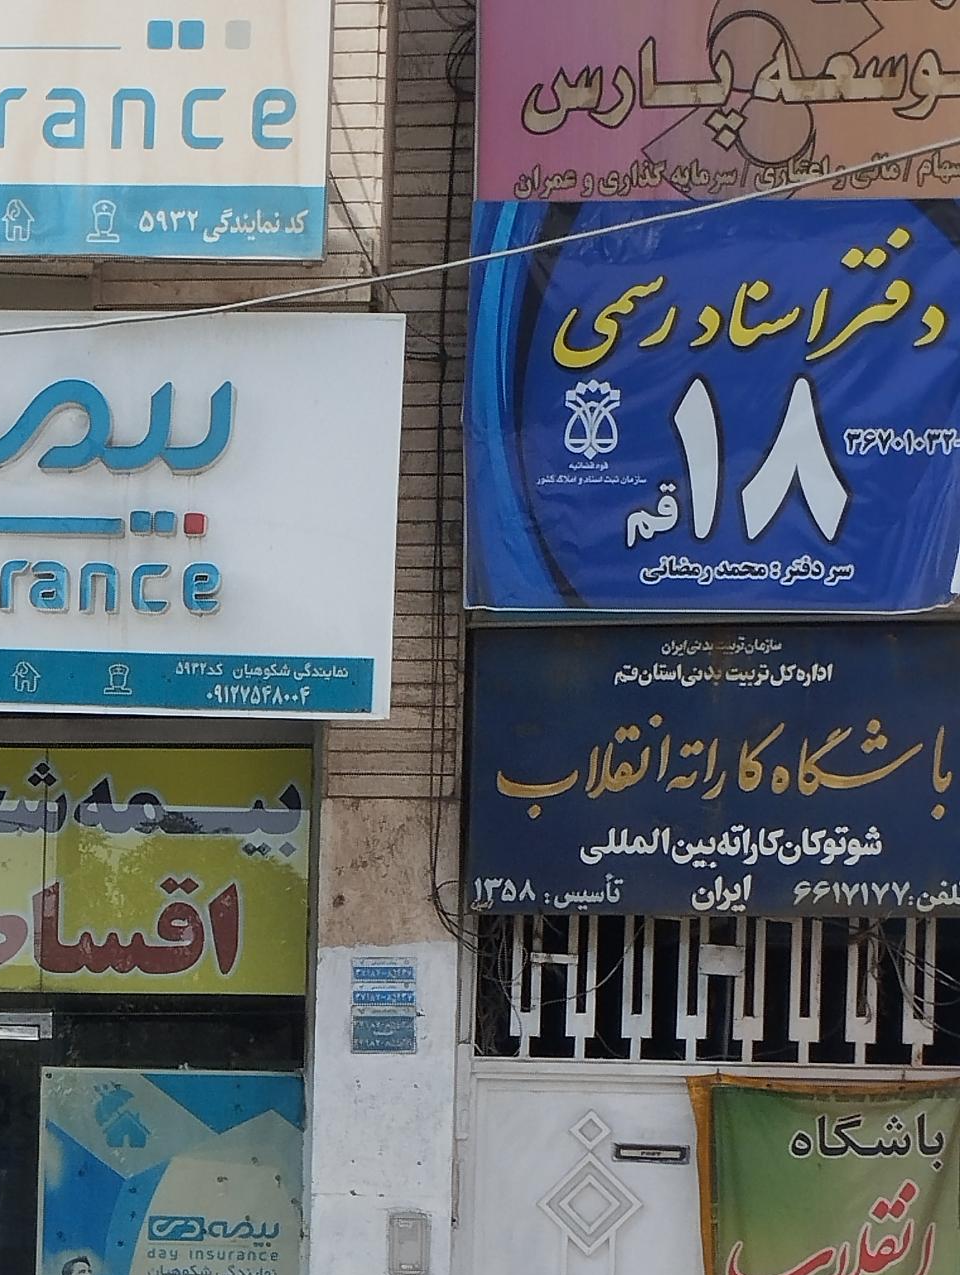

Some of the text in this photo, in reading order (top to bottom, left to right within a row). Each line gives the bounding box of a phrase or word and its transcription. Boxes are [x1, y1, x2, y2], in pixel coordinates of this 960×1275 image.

[521, 36, 746, 151] پارس
[514, 163, 577, 199] عمران
[581, 173, 594, 197] و
[671, 158, 739, 194] سرمایه
[138, 207, 309, 244] کد نمایندگی ۵۹۳۲
[552, 227, 946, 369] دفتر اسناد رسمی
[626, 376, 850, 548] ۱۸ قم
[640, 555, 714, 585] رمضانی
[715, 559, 769, 581] محمد
[823, 561, 855, 586] سر
[661, 636, 783, 657] سازمان تربیت بدنی ایران
[232, 662, 291, 681] شکوهیان
[293, 662, 349, 682] نمایندگی
[638, 662, 682, 687] استان
[681, 663, 724, 687] بدنی
[725, 662, 770, 687] تربیت
[770, 662, 797, 686] کل
[797, 662, 834, 687] اداره
[206, 684, 311, 706] ۰۹۱۲۷۵۴۸۰۰۴
[496, 713, 953, 820] باشگاه کاراته انقلاب
[73, 774, 303, 859] بیمه
[580, 824, 883, 869] شوتوکان کاراته بین المللی
[473, 876, 537, 903] ۱۳۵۸
[690, 873, 753, 913] ایران
[792, 880, 910, 907] ۶۶۱۷۱۷۷
[788, 1112, 945, 1170] باشگاه
[207, 1219, 280, 1248] بیمه
[147, 1248, 279, 1262] day insurance
